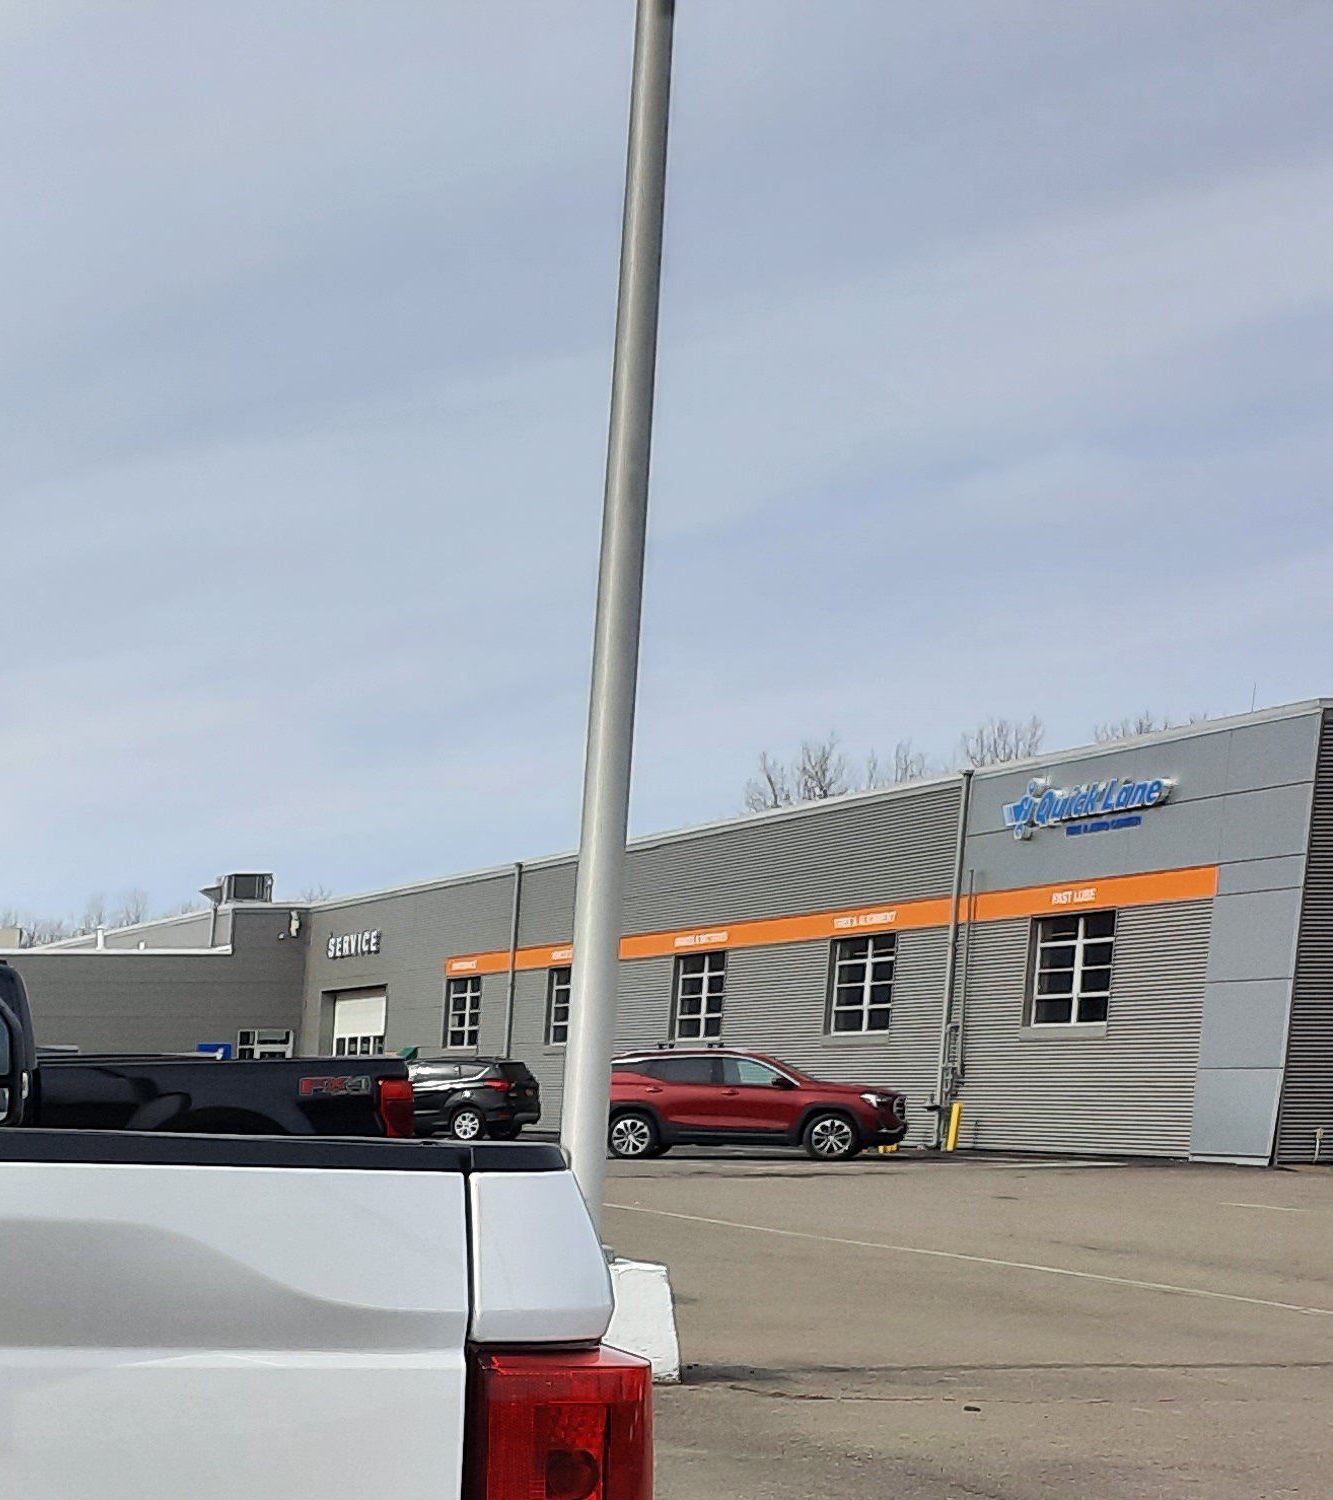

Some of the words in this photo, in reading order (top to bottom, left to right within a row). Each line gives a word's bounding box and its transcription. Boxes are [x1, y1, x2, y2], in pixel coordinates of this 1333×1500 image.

[1035, 781, 1102, 827] Quick
[1101, 777, 1164, 810] Lane
[326, 930, 379, 958] SERVICE
[299, 1075, 371, 1096] FX4
